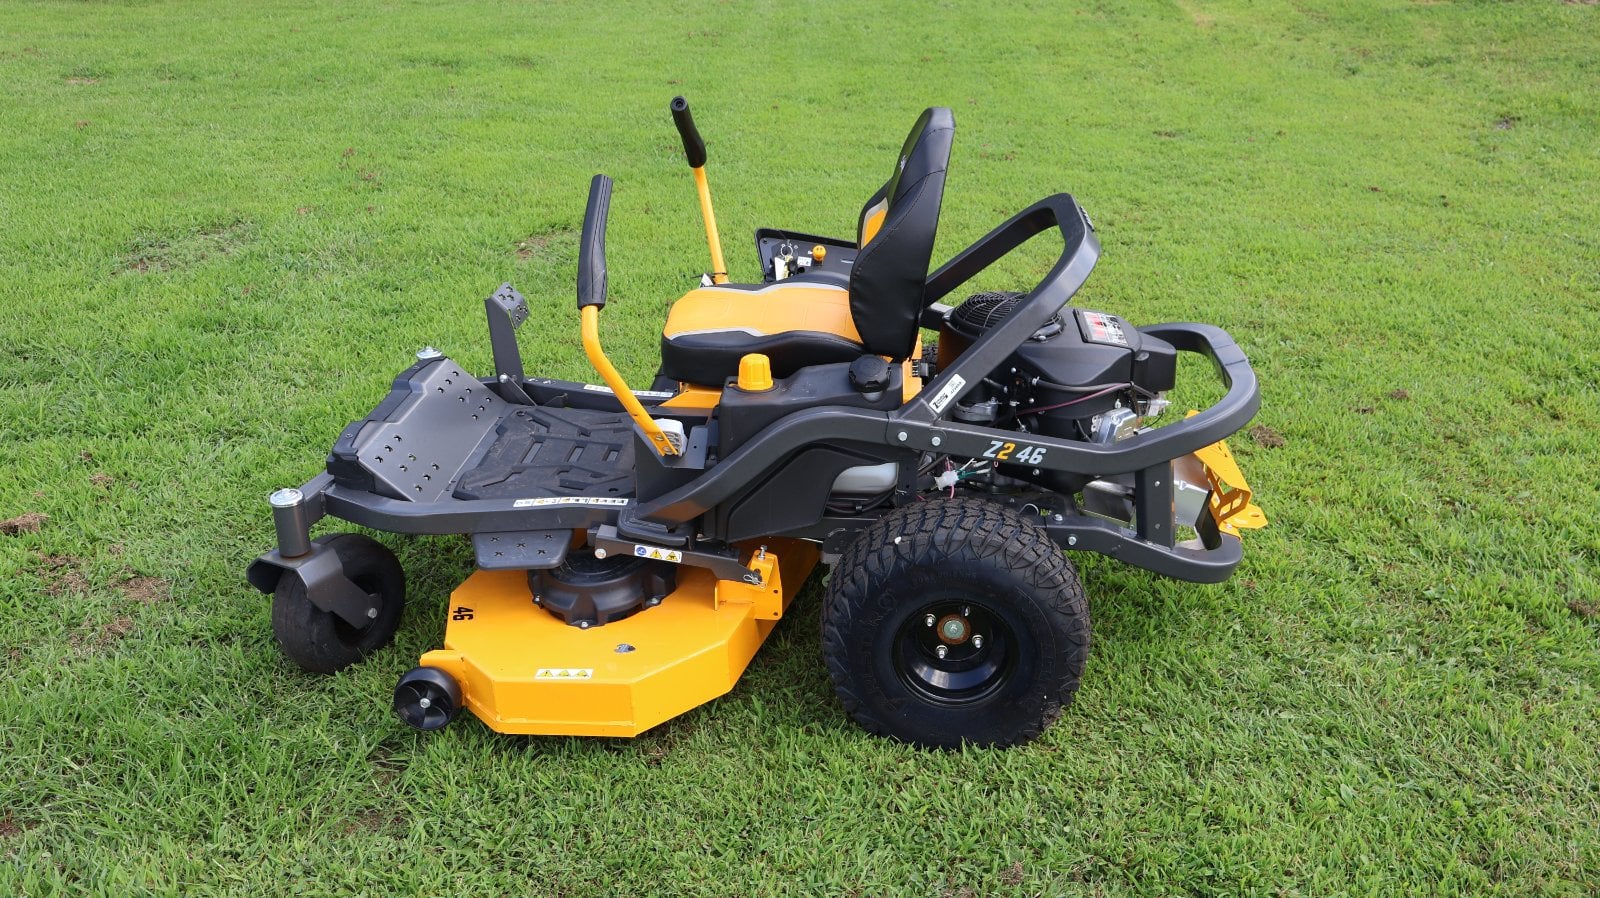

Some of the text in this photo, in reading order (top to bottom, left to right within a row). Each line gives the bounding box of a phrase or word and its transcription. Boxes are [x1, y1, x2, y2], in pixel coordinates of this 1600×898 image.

[982, 440, 1047, 465] Z2 46
[452, 606, 474, 621] 46
